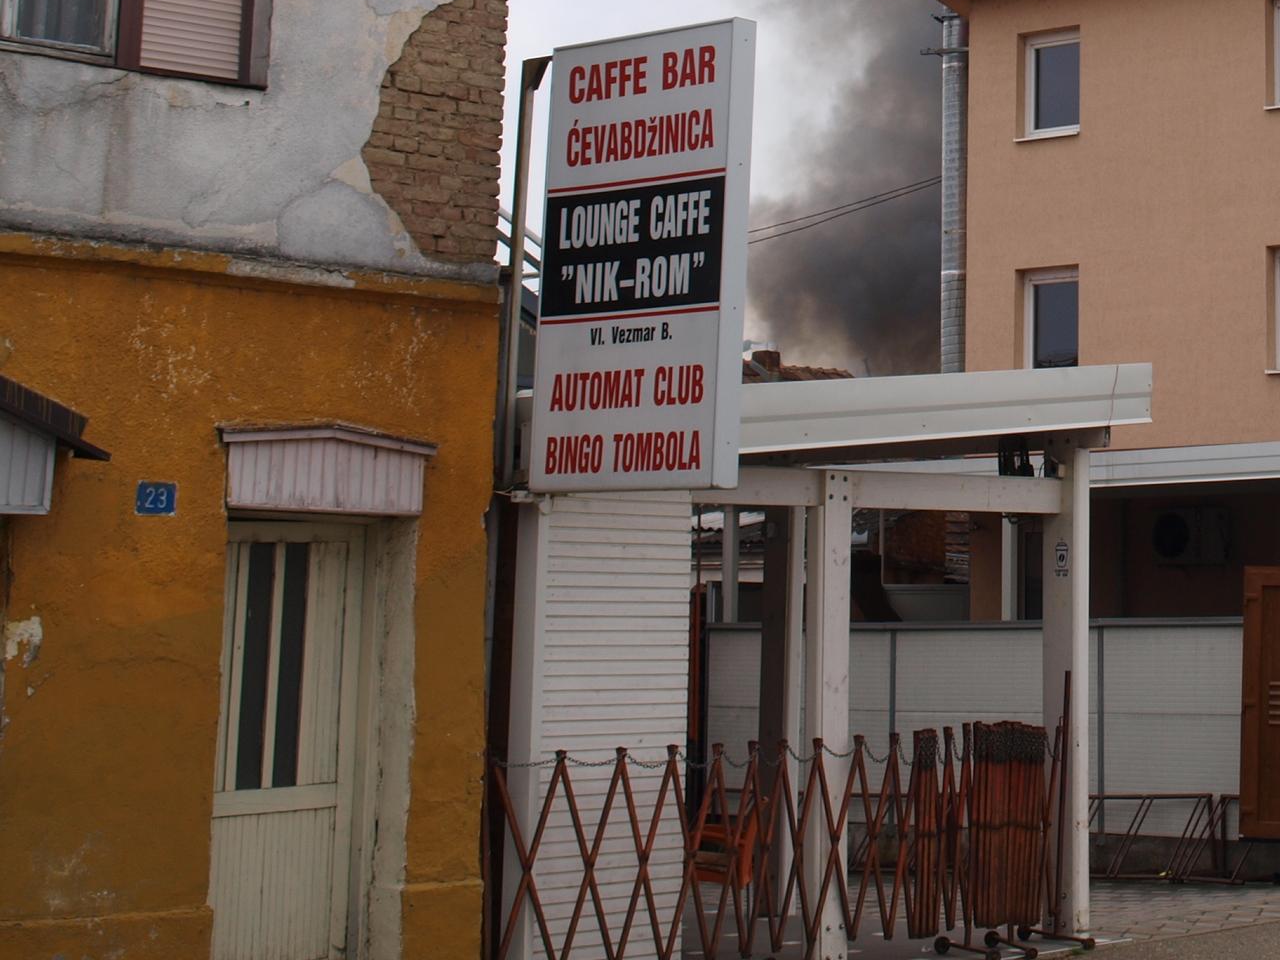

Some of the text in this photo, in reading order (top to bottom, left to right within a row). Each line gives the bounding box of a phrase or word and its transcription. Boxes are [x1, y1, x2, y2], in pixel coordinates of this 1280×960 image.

[569, 45, 715, 104] CAFFE BAR
[559, 190, 711, 249] LOUNGE CAFFE
[612, 324, 656, 344] Vezmar
[661, 322, 673, 340] B.
[550, 364, 704, 412] AUTOMAT CLUB
[545, 430, 700, 474] BINGO TOMBOLA
[145, 487, 168, 508] 23
